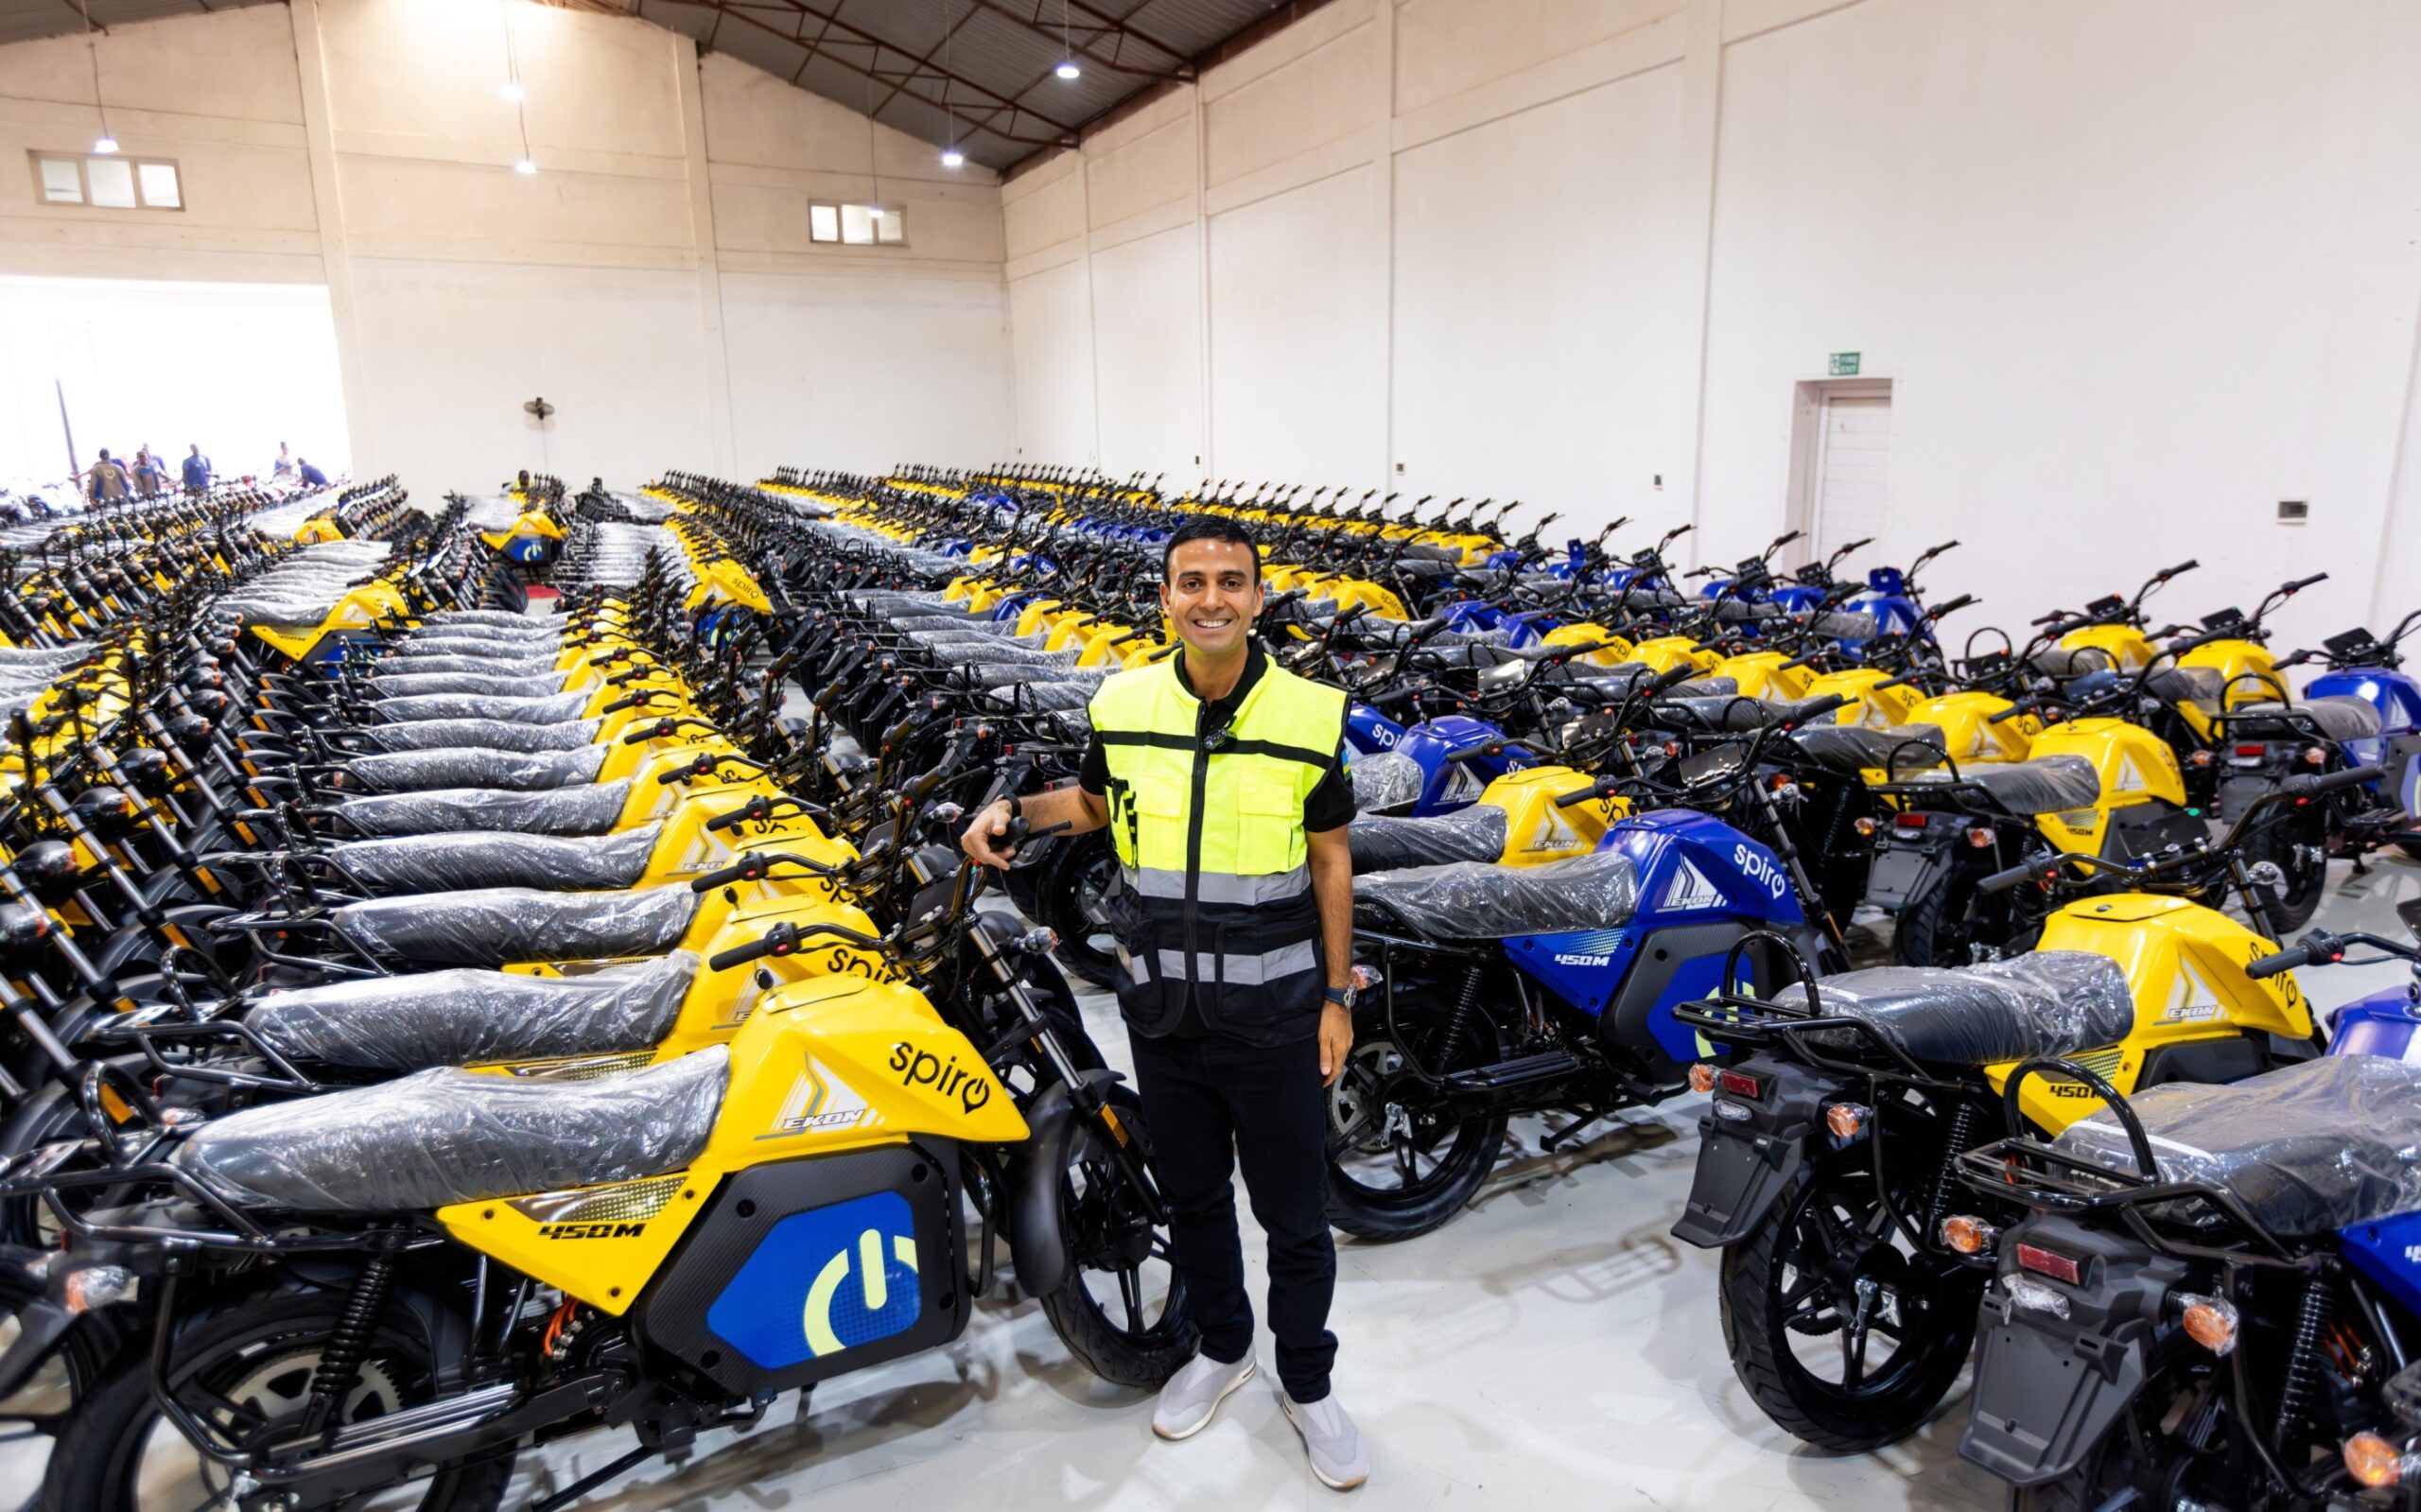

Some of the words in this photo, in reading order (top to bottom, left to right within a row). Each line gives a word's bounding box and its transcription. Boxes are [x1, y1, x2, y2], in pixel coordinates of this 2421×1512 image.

[1379, 592, 1403, 617] spiro
[1613, 638, 1632, 659] spi
[1372, 722, 1402, 751] spi
[1534, 838, 1577, 849] EKON
[684, 861, 726, 871] EKO
[1734, 843, 1786, 899] spiro
[1672, 895, 1715, 907] EKON
[1554, 953, 1611, 966] 450M
[2168, 1004, 2217, 1018] EKON
[889, 1041, 990, 1115] spiro
[782, 1108, 865, 1130] EKON
[538, 1223, 647, 1241] 450M
